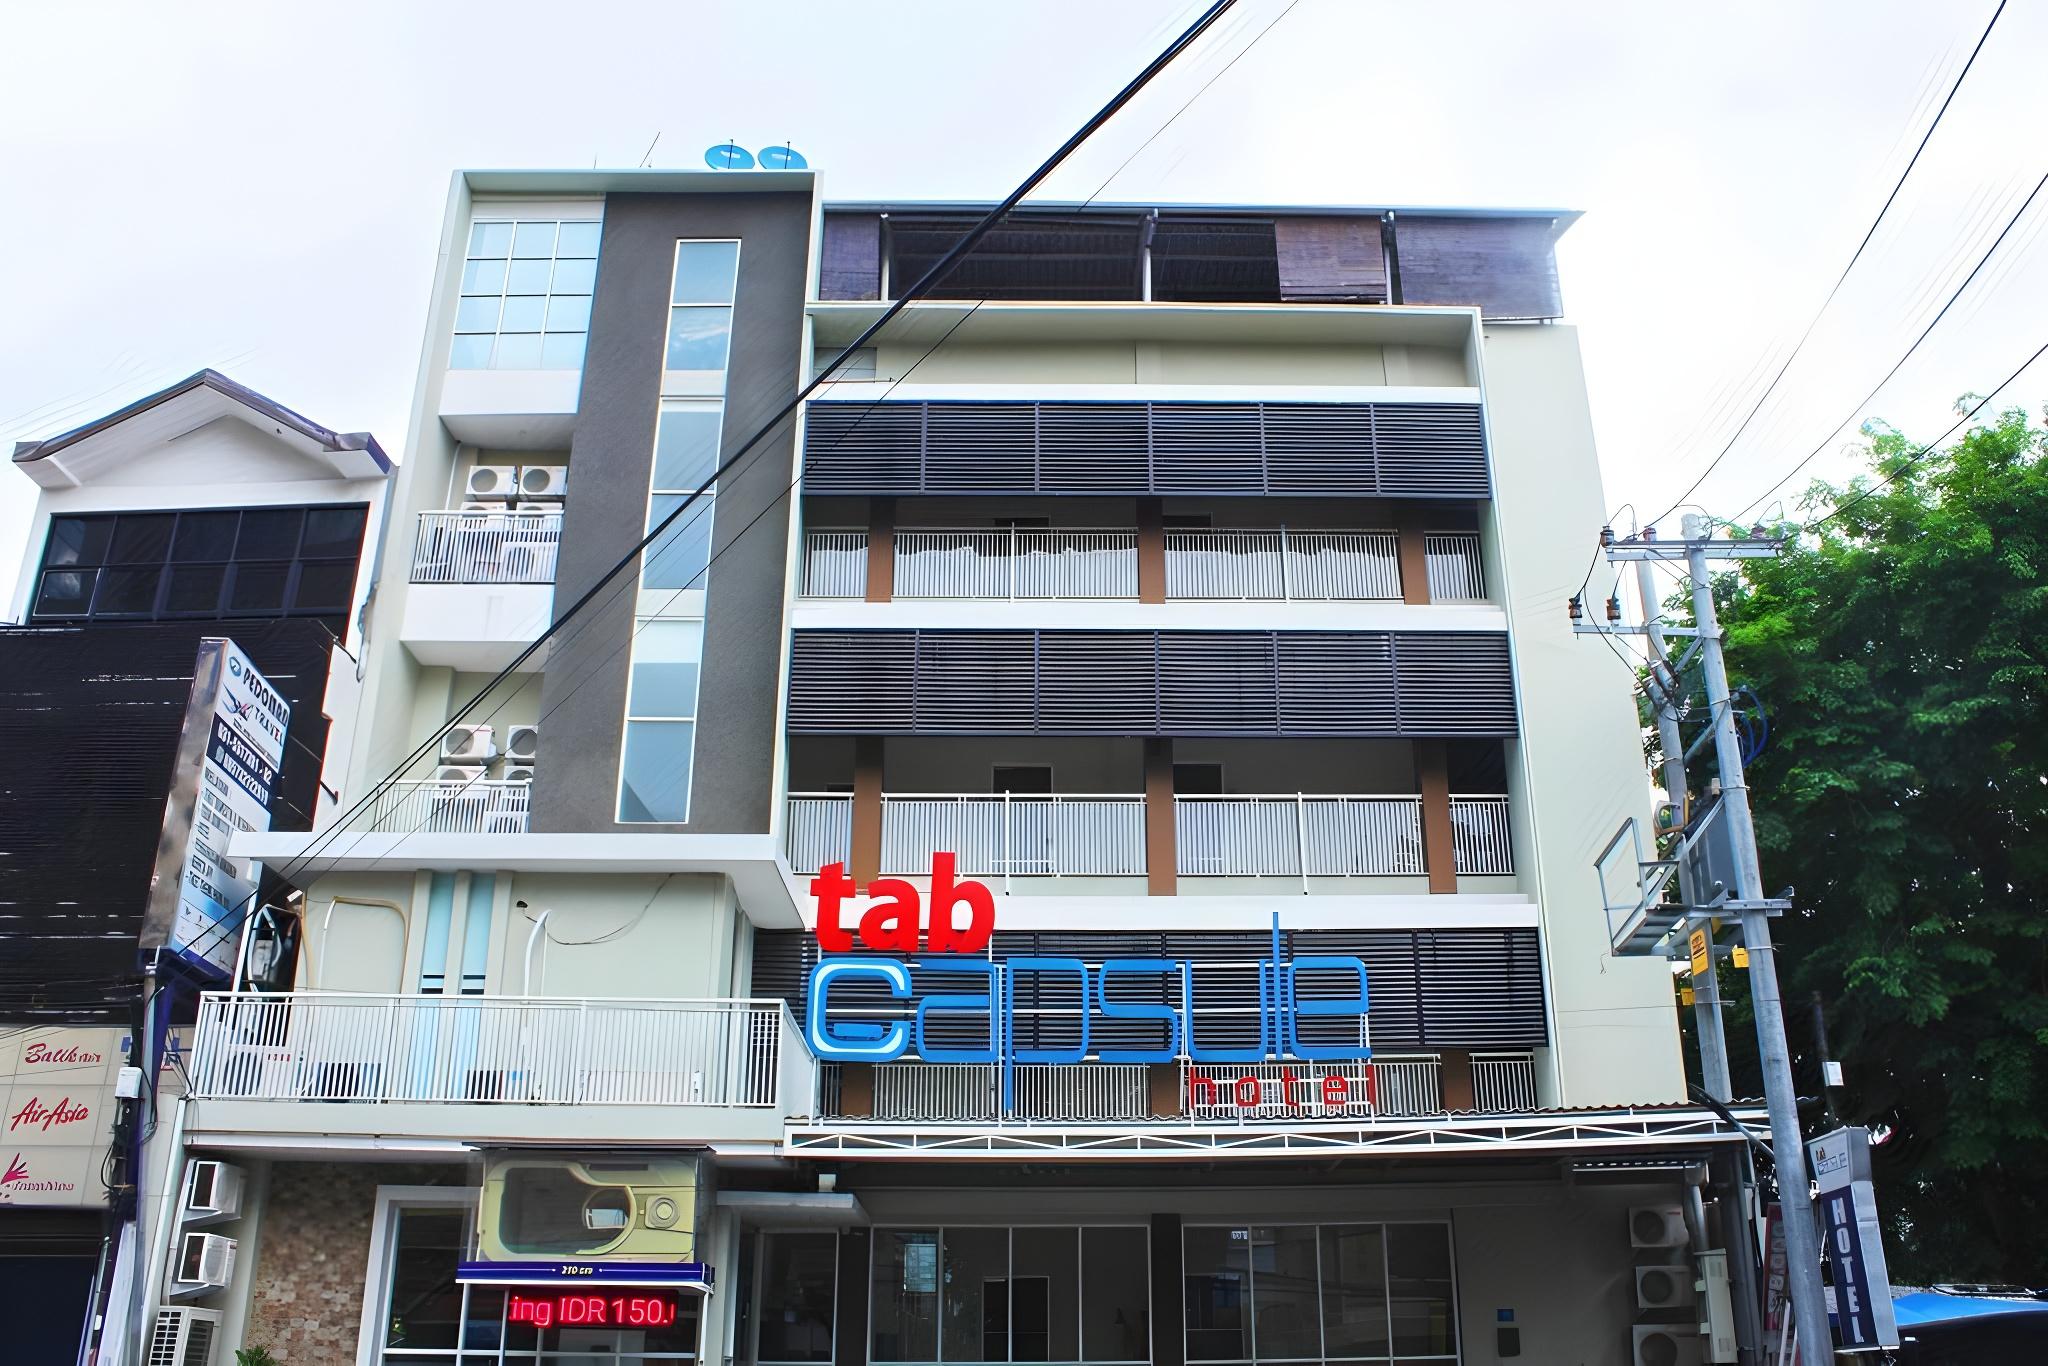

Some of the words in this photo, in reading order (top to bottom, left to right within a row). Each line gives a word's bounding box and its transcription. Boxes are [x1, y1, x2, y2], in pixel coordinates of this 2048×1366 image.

[809, 852, 995, 953] tab
[806, 912, 1372, 1112] capsule
[1188, 1065, 1375, 1109] hotel
[560, 1298, 606, 1322] IDR
[1831, 1197, 1865, 1343] HOTEL
